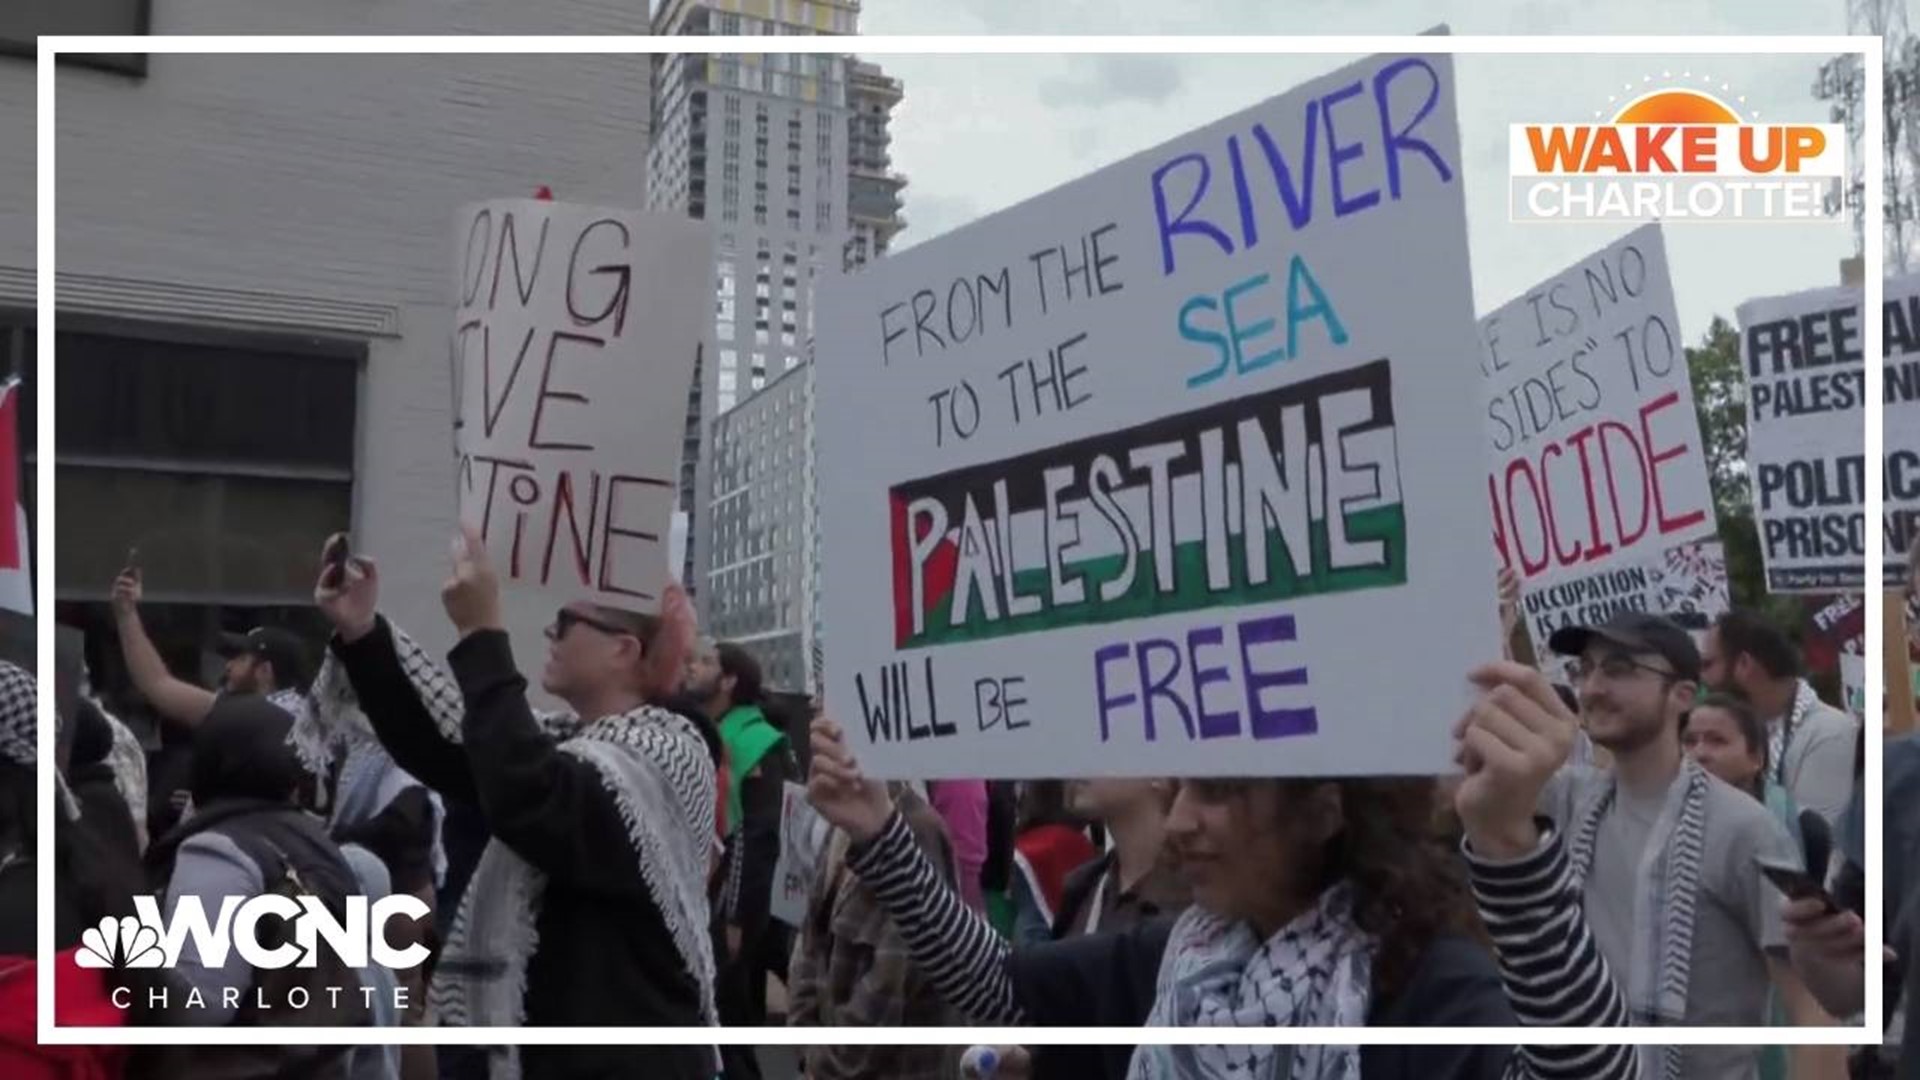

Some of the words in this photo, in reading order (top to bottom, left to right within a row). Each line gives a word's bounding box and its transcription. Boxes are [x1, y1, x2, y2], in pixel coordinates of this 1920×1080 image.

[879, 266, 1012, 365] FROM
[1029, 222, 1123, 314] THE
[1152, 56, 1453, 276] RIVER
[928, 378, 980, 448] TO
[999, 332, 1092, 424] THE
[1178, 254, 1348, 388] SEA
[1527, 282, 1579, 347] IS
[1584, 245, 1646, 317] NO
[1614, 313, 1674, 391] TO
[1747, 304, 1863, 378] FREE
[906, 387, 1387, 635] PALESTINE
[1525, 565, 1647, 614] OCCUPATION
[855, 657, 957, 743] WILL
[975, 677, 1031, 731] BE
[1095, 614, 1318, 742] FREE
